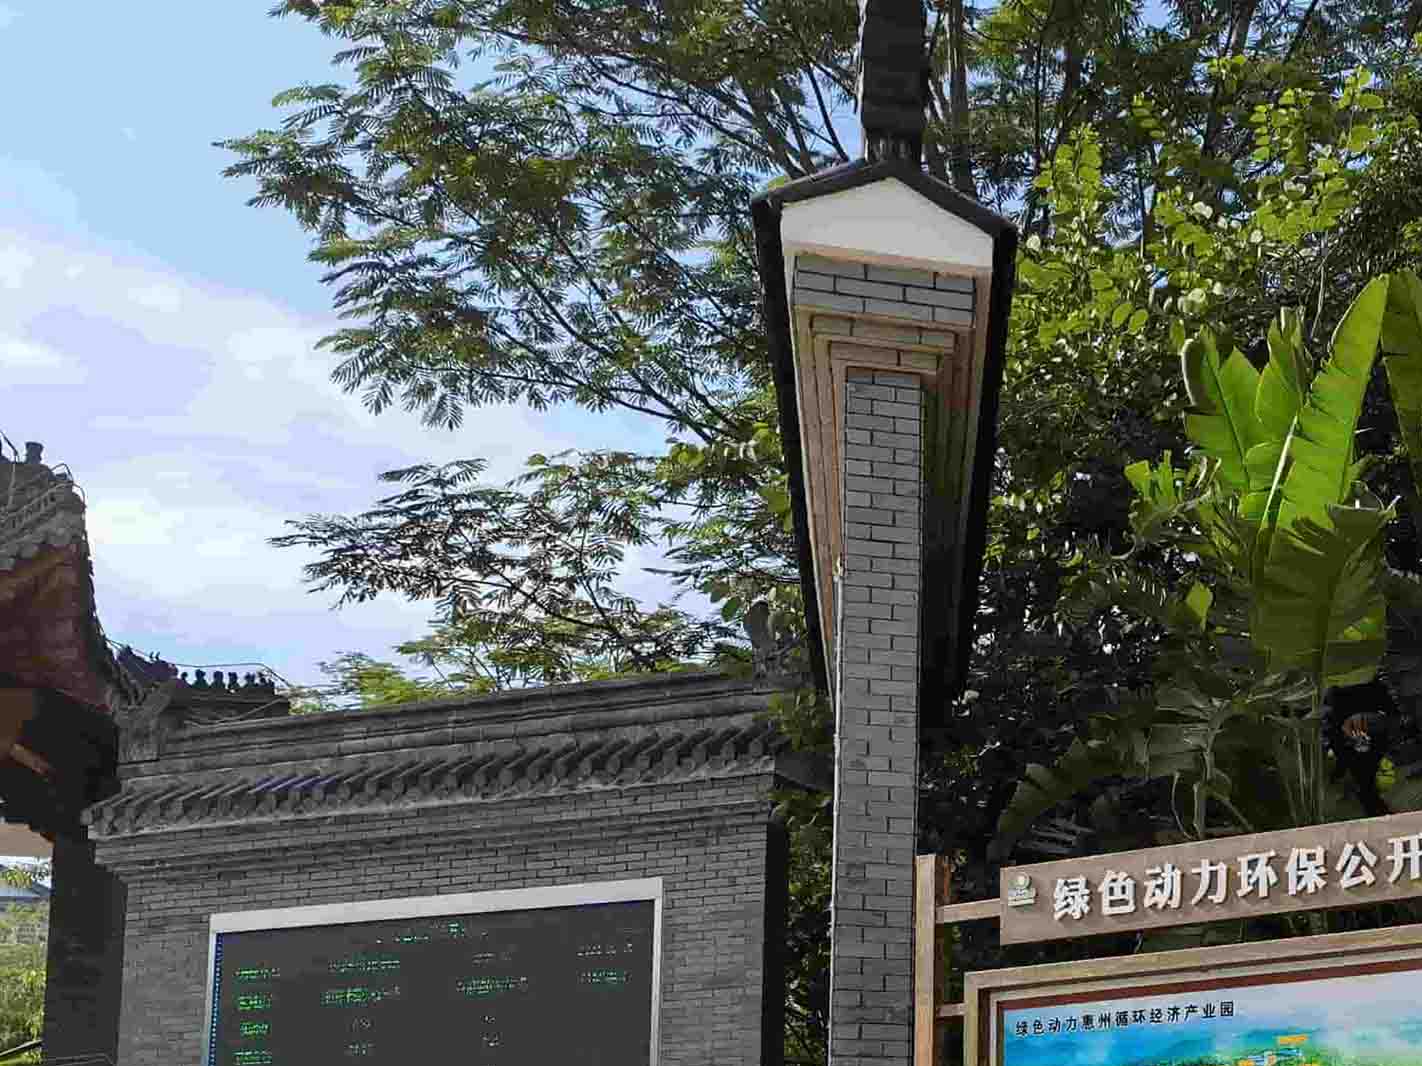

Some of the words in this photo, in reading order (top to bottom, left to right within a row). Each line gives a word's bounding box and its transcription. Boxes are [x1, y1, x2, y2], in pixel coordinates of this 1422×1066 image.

[1015, 1001, 1234, 1037] 绿色动力惠州循环经济产业园
